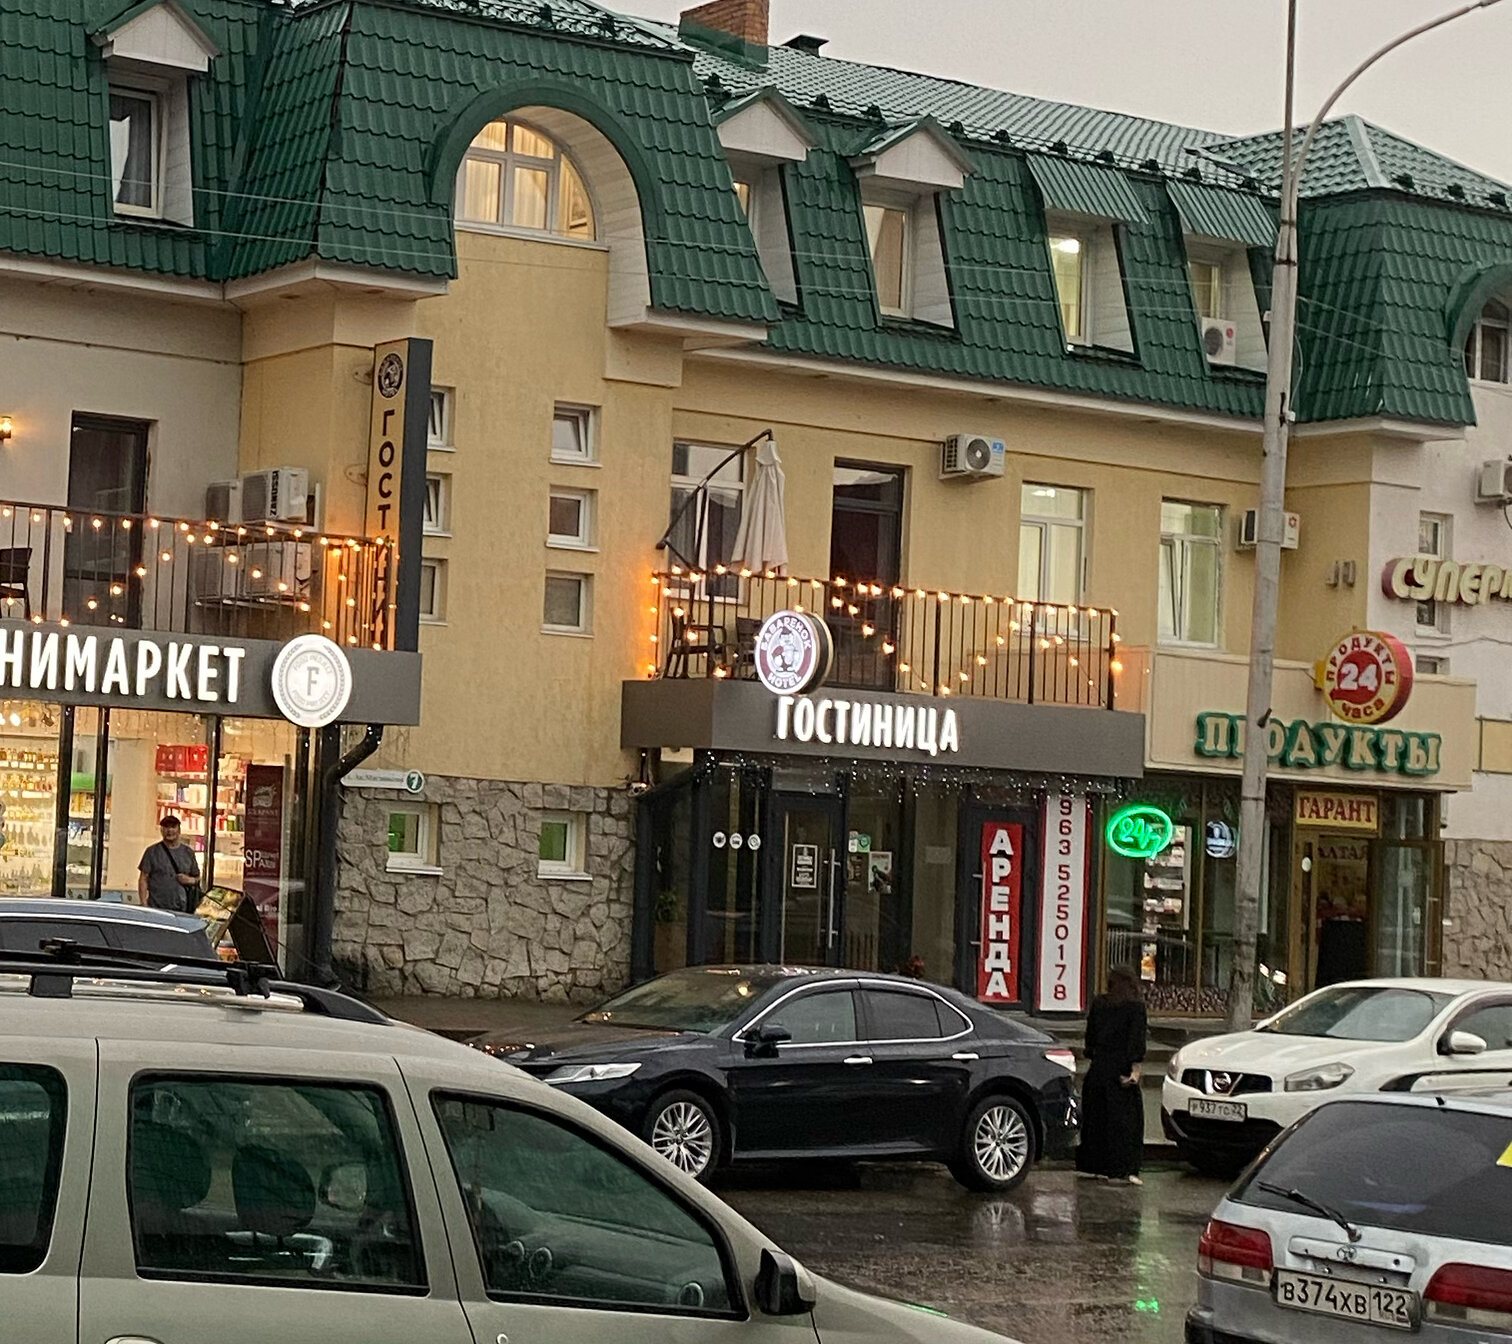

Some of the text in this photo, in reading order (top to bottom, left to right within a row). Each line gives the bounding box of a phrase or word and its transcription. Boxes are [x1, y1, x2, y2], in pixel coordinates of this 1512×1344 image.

[1326, 636, 1395, 685] ПРОДУКТЫ
[1339, 662, 1378, 692] 24
[768, 672, 803, 689] HOTEL
[777, 695, 959, 757] ГОСТИНИЦА
[1299, 796, 1375, 823] ГАРАНТ
[984, 828, 1015, 998] АРЕНДА
[1280, 1277, 1407, 1316] В374ХВ 122
